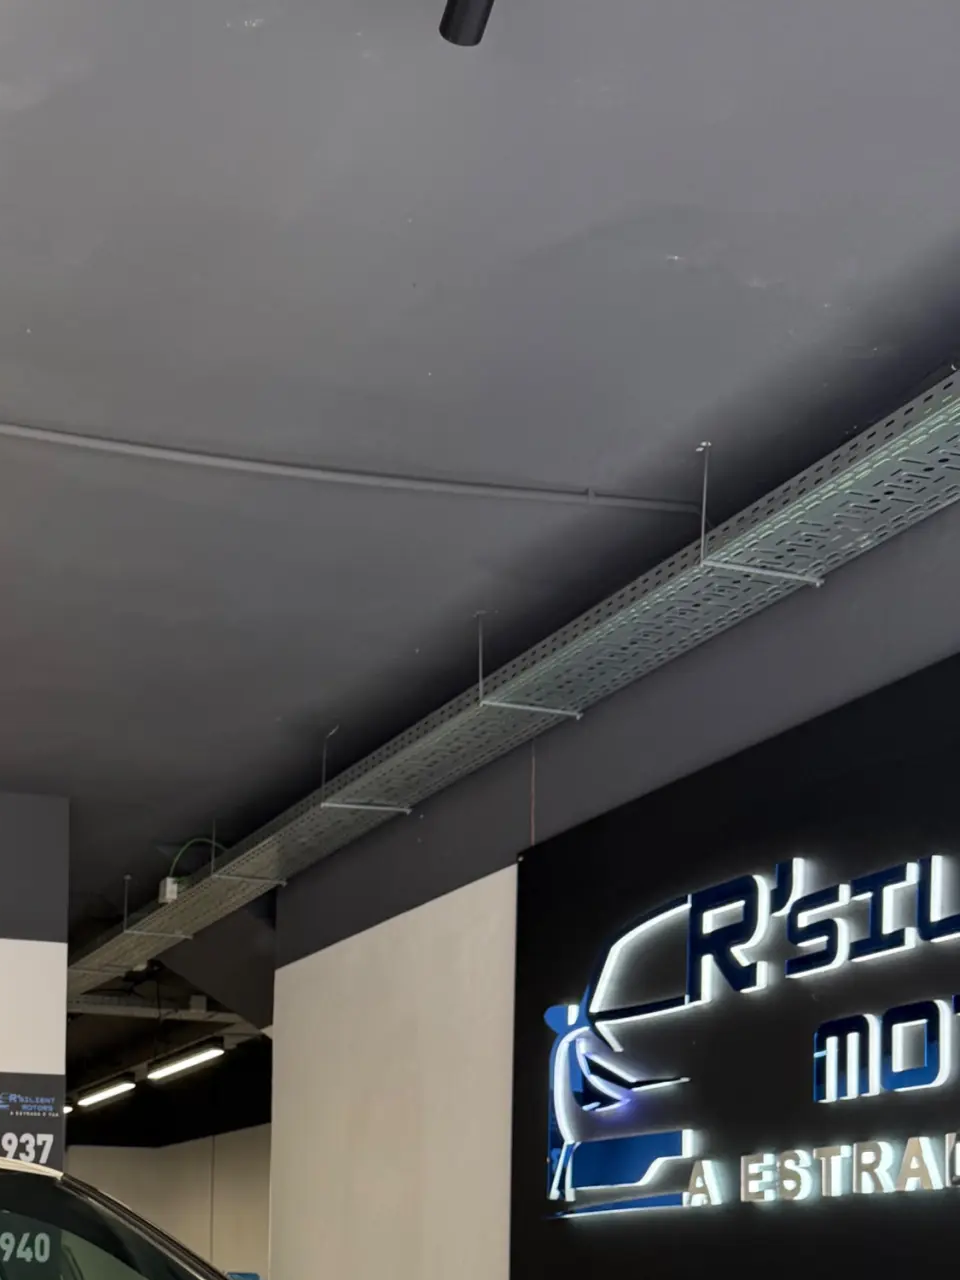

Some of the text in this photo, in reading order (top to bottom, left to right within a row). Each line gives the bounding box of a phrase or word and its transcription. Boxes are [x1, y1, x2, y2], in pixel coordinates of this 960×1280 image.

[813, 994, 960, 1102] MO
[1, 1132, 54, 1164] 937
[688, 1160, 722, 1206] A
[0, 1231, 51, 1263] 940
